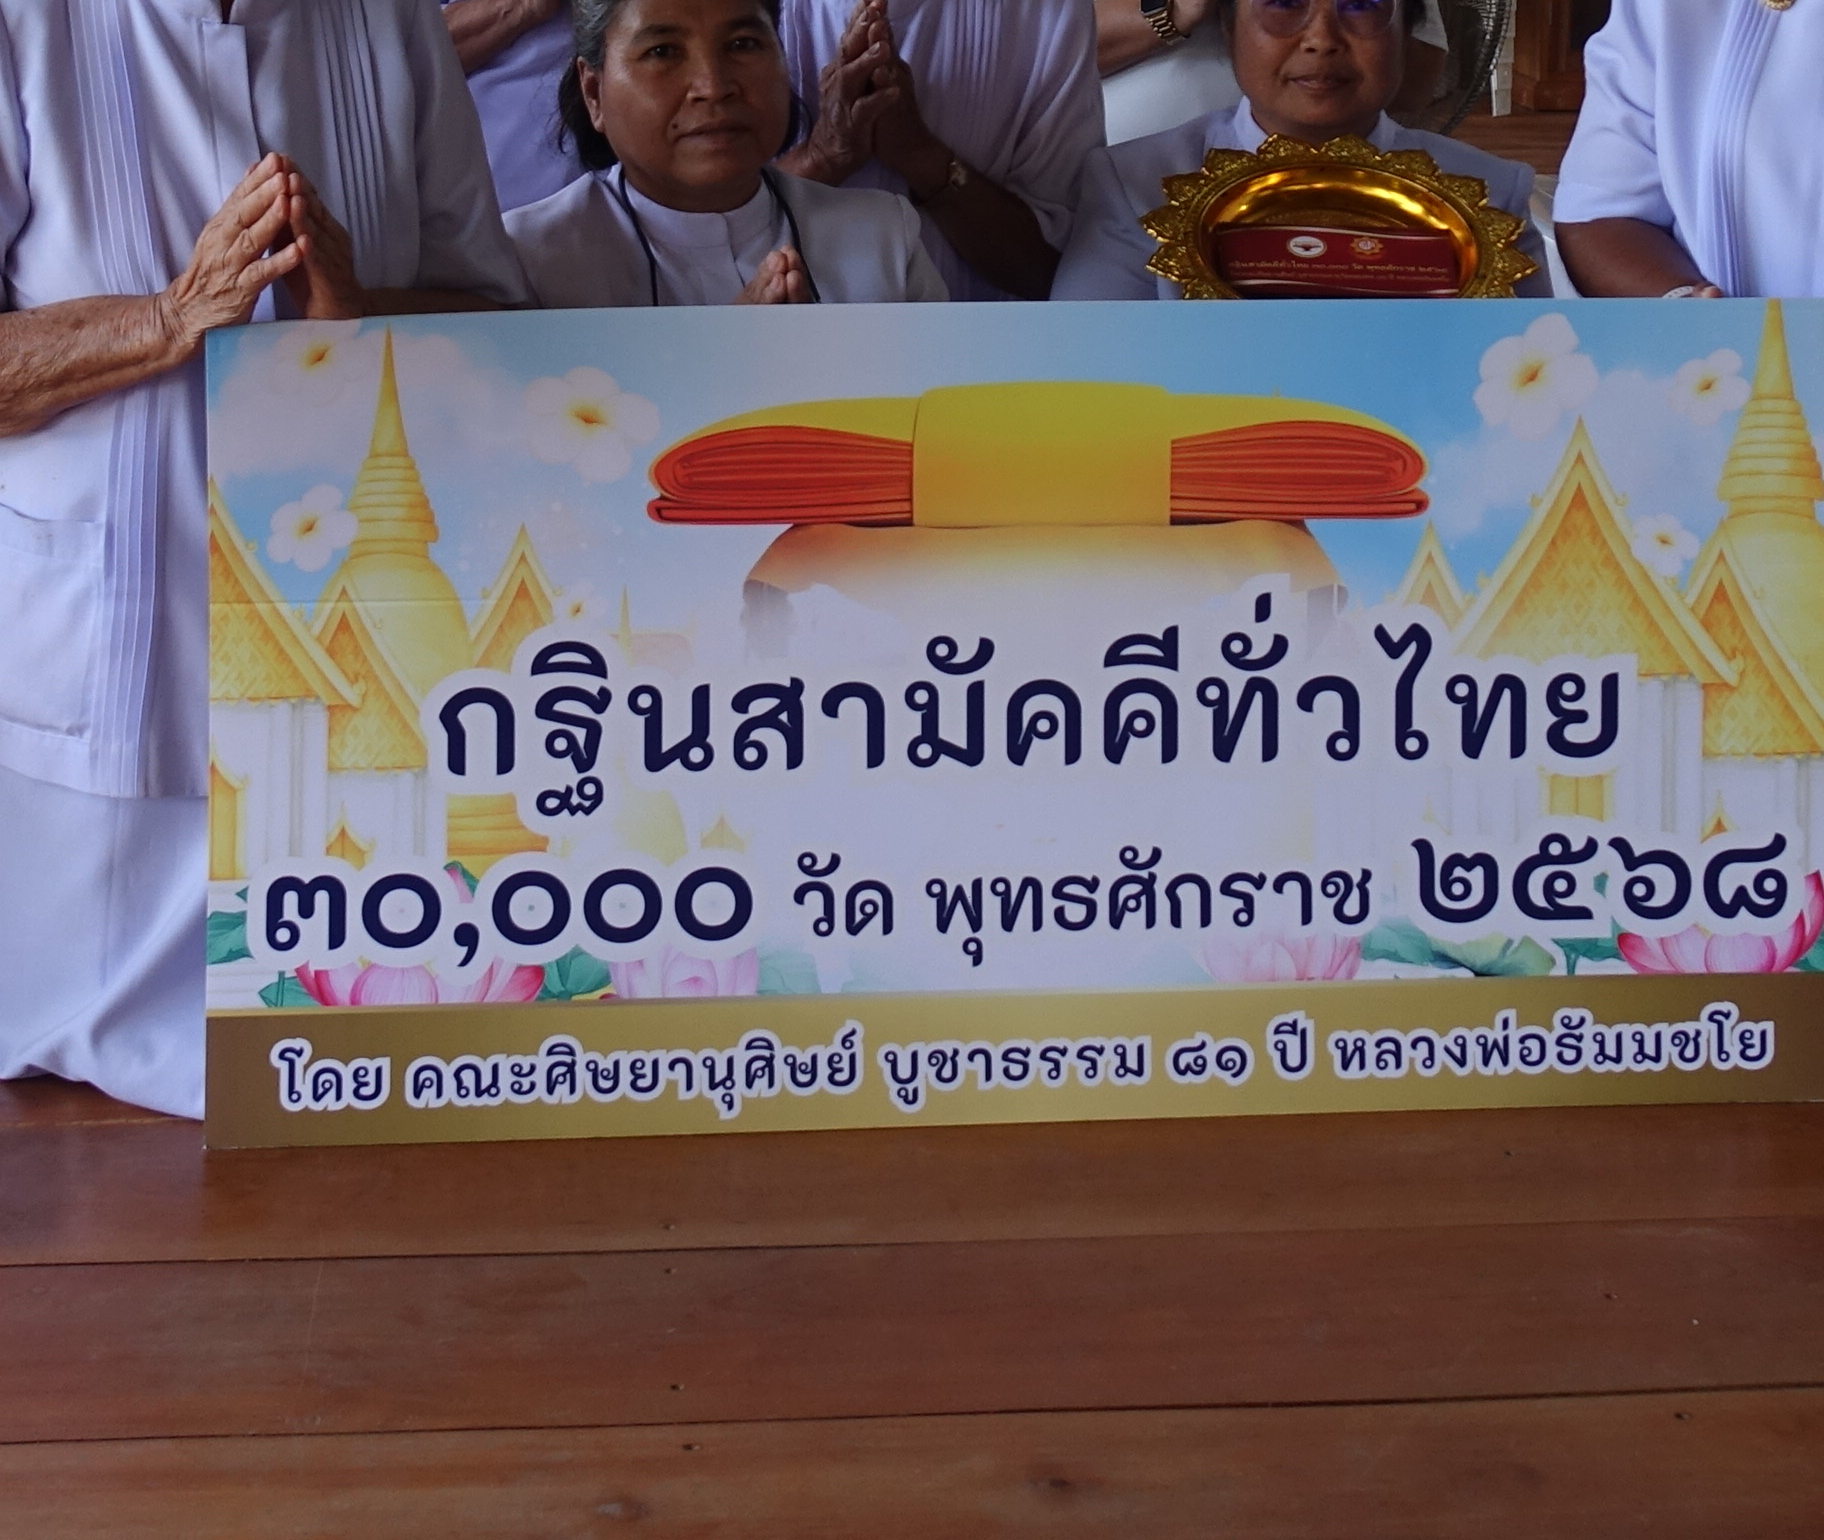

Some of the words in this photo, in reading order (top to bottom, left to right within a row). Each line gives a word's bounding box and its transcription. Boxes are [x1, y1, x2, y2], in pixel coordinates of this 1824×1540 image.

[437, 591, 1620, 818] กฐินสามัคคีทั่วไทย
[264, 866, 754, 969] ๓๐,๐๐๐
[792, 849, 895, 938] วัด
[924, 844, 1374, 969] พุทธศักราช
[1409, 831, 1790, 926] ๒๕๖๘
[277, 1046, 385, 1105] โดย
[410, 1025, 862, 1115] คณะศิษยานุศิษย์
[883, 1040, 1145, 1107] บูชาธรรม
[1171, 1039, 1249, 1080] ๘๑
[1272, 1019, 1309, 1073] ปี
[1333, 1008, 1768, 1073] หลวงพ่อธัมมชโย
